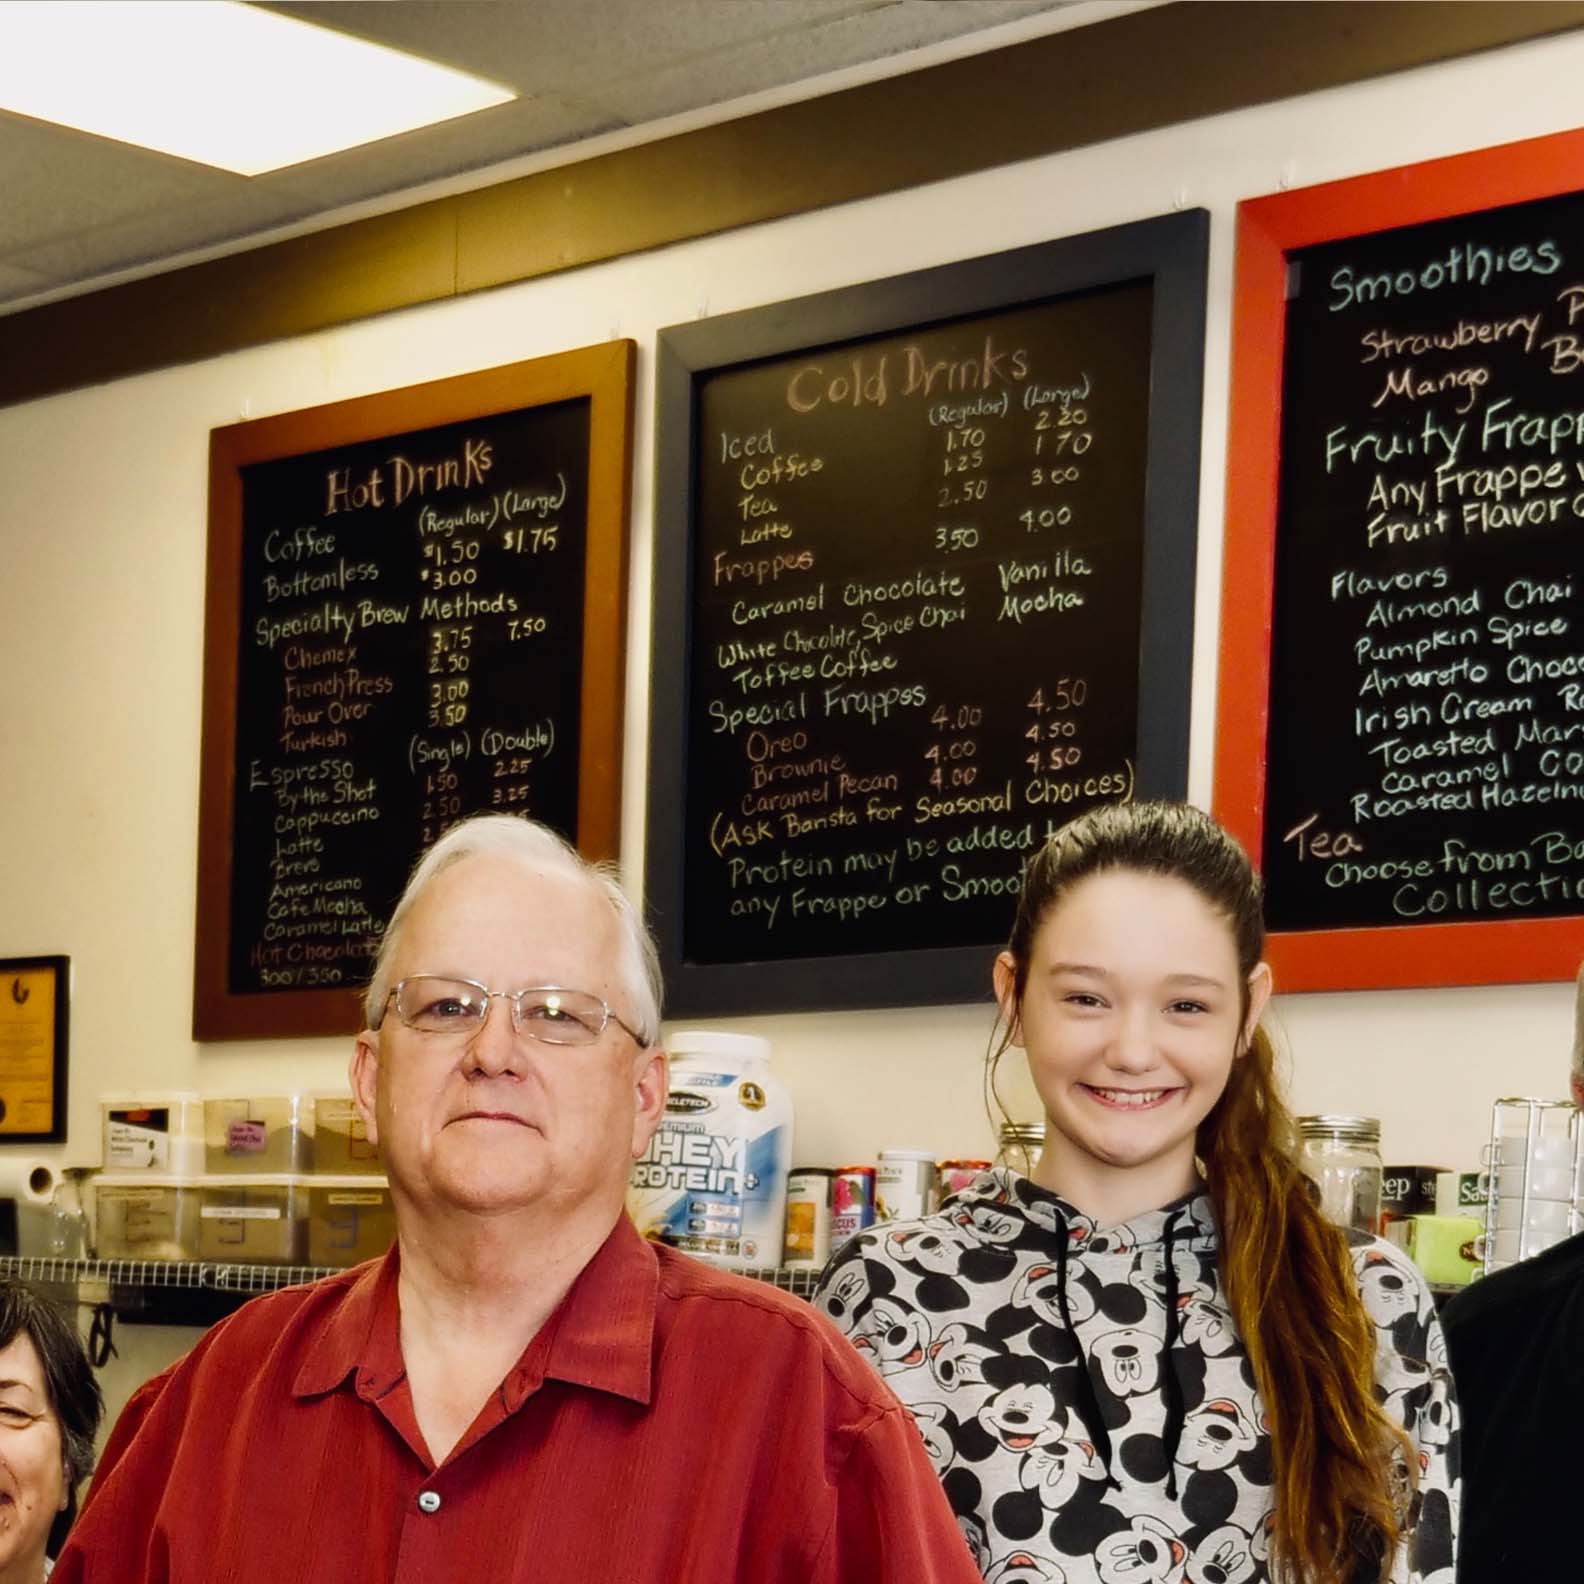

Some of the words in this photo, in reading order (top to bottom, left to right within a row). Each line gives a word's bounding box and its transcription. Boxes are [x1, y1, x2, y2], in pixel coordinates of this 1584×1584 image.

[1328, 238, 1563, 312] Smoothies
[1361, 312, 1542, 364] Strawberry
[786, 357, 888, 413] Cold
[904, 335, 1029, 397] Drinks
[1373, 366, 1490, 413] Mango
[720, 429, 775, 465] Iced
[1326, 411, 1466, 473] Fruity
[325, 466, 384, 517] Hot
[385, 438, 494, 508] Drinks
[740, 457, 824, 491] Coffee
[1367, 474, 1427, 510] Any
[1435, 460, 1567, 514] Frappe
[418, 498, 499, 538] (Regular)
[503, 472, 567, 520] (Large)
[738, 496, 778, 521] Tea
[1367, 512, 1446, 549] Fruit
[1462, 500, 1568, 535] Flavor
[264, 527, 336, 564] Coffee
[503, 527, 558, 554] $1.75
[740, 522, 793, 544] Latte
[264, 557, 379, 604] Bottomless
[714, 549, 814, 588] Frappes
[732, 585, 824, 626] Caramel
[843, 573, 965, 607] Chocolate
[998, 549, 1093, 592] Vanilla
[1331, 566, 1448, 600] Flavors
[256, 604, 354, 646] Specialty
[361, 601, 410, 627] Brew
[420, 593, 518, 621] Methods
[1366, 591, 1480, 627] Almond
[1504, 575, 1572, 610] Chai
[717, 641, 777, 669] White
[861, 613, 914, 651] Spice
[919, 603, 966, 628] Chai
[998, 589, 1084, 624] Mocha
[1354, 626, 1478, 663] Pumpkin
[1488, 616, 1567, 651] Spice
[284, 645, 358, 672] Chemex
[732, 662, 815, 695] Toffee
[820, 654, 898, 679] Coffee
[1358, 659, 1489, 696] Amaretto
[282, 705, 322, 729] Pour
[328, 700, 371, 725] Over
[709, 693, 807, 734] Special
[824, 685, 926, 725] Frappes
[1354, 706, 1432, 735] Irish
[1441, 697, 1533, 727] Cream
[280, 731, 347, 753] Turkish
[481, 719, 555, 757] (Double)
[746, 731, 807, 762] Oreo
[1369, 731, 1495, 766] Toasted
[249, 760, 354, 792] Espresso
[741, 782, 829, 815] Caramel
[839, 772, 898, 802] Pecan
[751, 755, 846, 790] Brownie
[1381, 757, 1509, 795] Caramel
[710, 813, 774, 856] (Ask
[786, 806, 857, 837] Barista
[866, 800, 902, 823] for
[915, 780, 1012, 823] Seasonal
[1025, 759, 1135, 805] Choices)
[1351, 789, 1474, 823] Roasted
[729, 853, 832, 888] Protein
[844, 849, 898, 882] may
[907, 837, 940, 861] be
[947, 823, 1033, 851] added
[1283, 815, 1363, 860] Tea
[1325, 857, 1434, 887] Choose
[1441, 842, 1533, 874] from
[731, 896, 780, 929] any
[792, 887, 886, 920] Frappe
[896, 883, 929, 905] or
